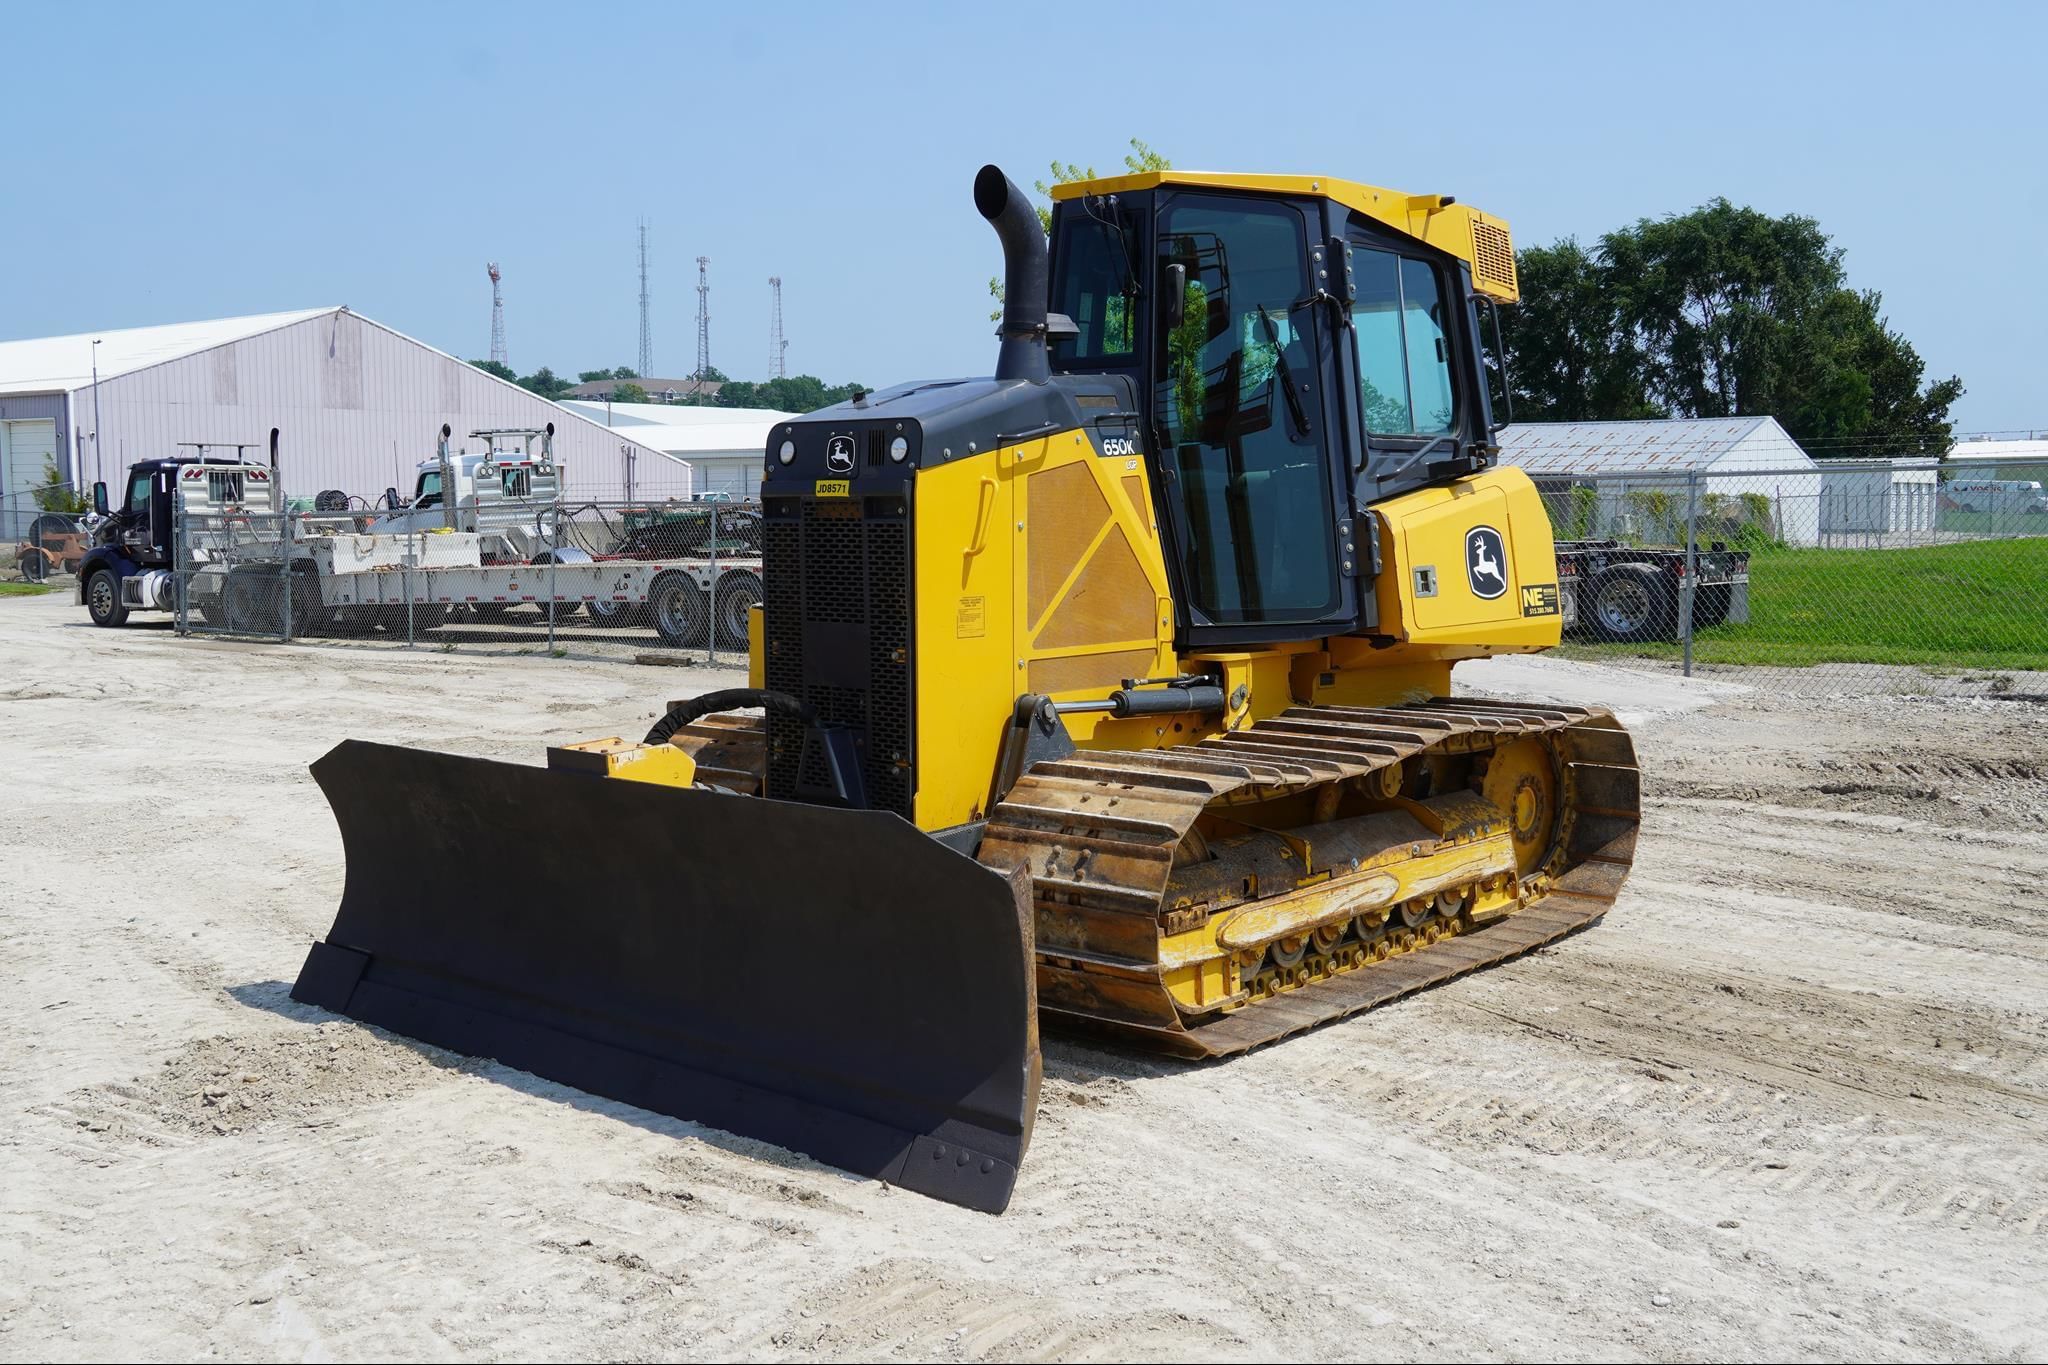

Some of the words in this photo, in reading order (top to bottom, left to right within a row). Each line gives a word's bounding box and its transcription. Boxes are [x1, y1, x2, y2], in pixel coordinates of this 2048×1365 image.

[1103, 438, 1135, 456] 650K
[817, 484, 846, 493] JD8571
[1522, 587, 1544, 607] NE
